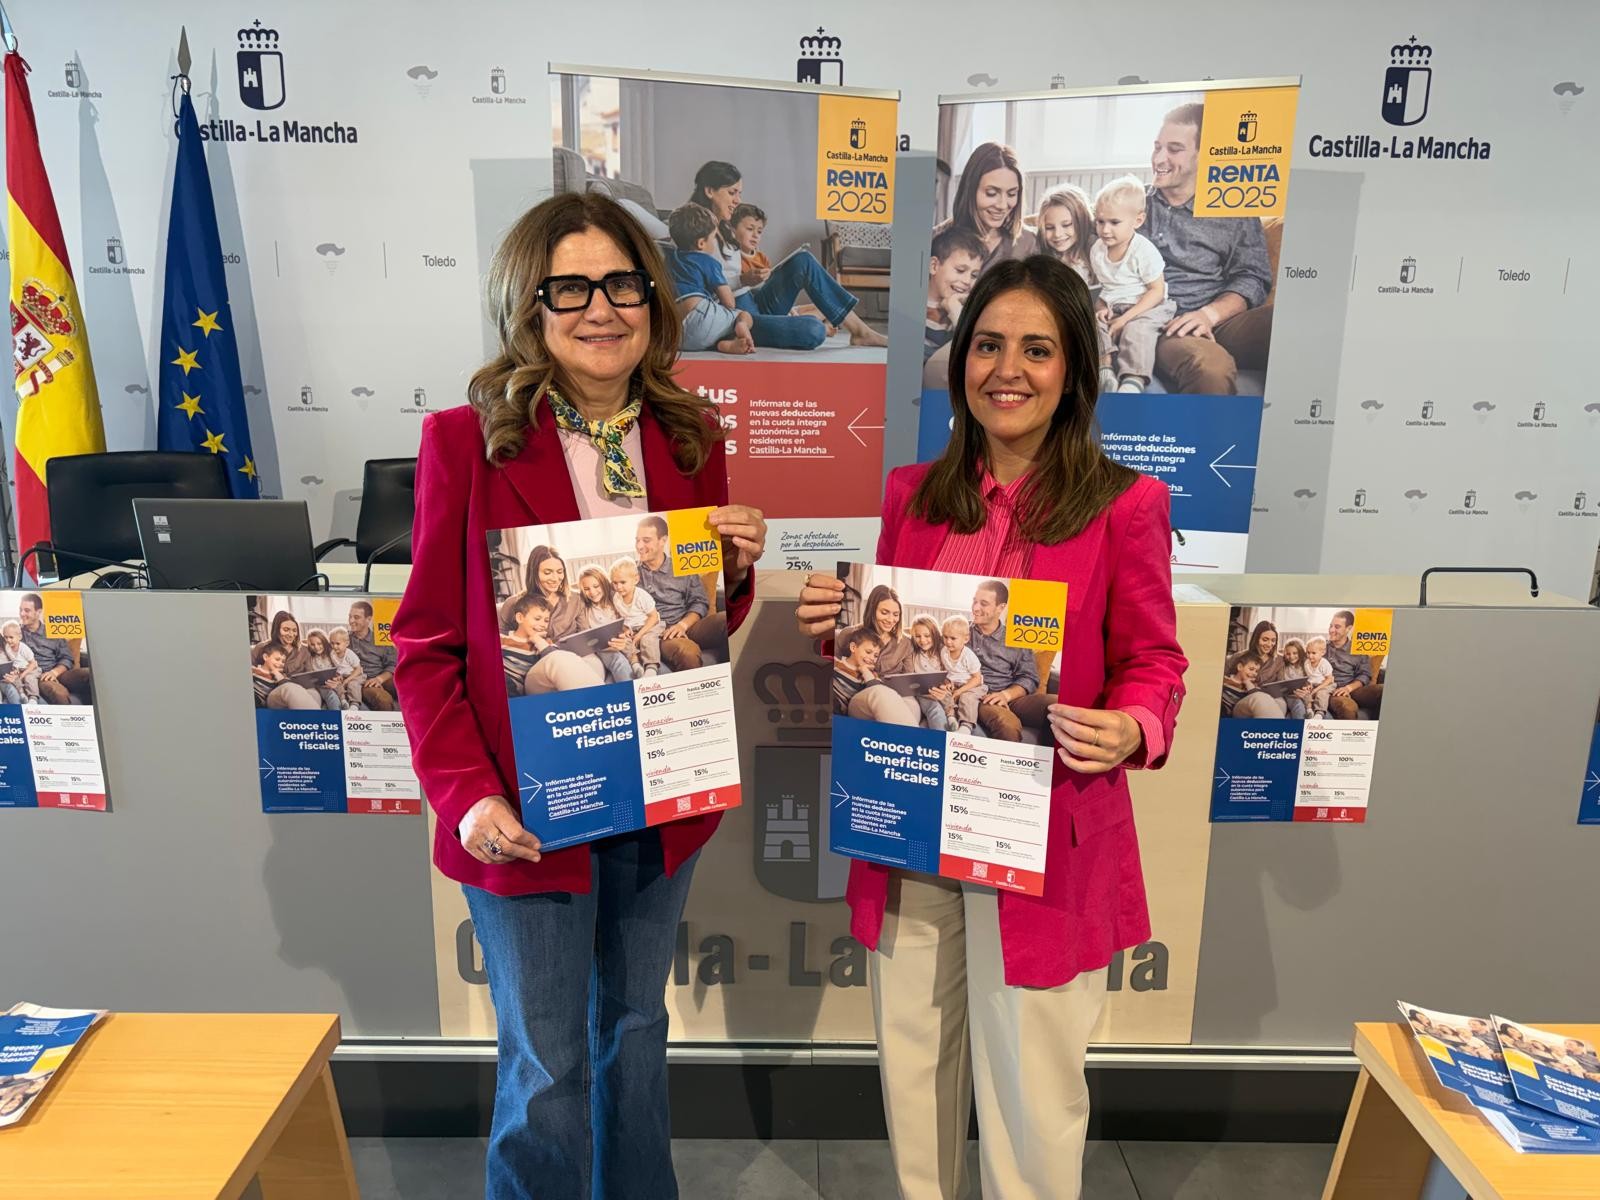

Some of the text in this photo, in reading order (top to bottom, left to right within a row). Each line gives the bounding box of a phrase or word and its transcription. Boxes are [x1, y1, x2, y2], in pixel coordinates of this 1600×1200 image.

[283, 120, 358, 143] Mancha
[1252, 145, 1282, 154] Mancha
[1417, 136, 1491, 160] Mancha
[863, 153, 888, 163] Mancha
[827, 190, 887, 214] 2025
[1206, 186, 1277, 208] 2025
[422, 254, 456, 267] Toledo
[1285, 266, 1318, 279] Toledo
[1498, 269, 1531, 282] Toledo
[1411, 286, 1434, 294] Mancha
[697, 385, 738, 404] tus
[749, 400, 818, 408] Infórmate de las
[780, 409, 836, 418] deducciones
[762, 418, 770, 426] la
[749, 437, 793, 445] residentes
[1101, 433, 1176, 443] Infórmate de las
[793, 446, 827, 454] Mancha
[1134, 444, 1197, 454] deducciones
[1112, 452, 1121, 461] la
[1122, 454, 1149, 462] cuota
[1155, 465, 1177, 473] para
[781, 531, 839, 540] Zonas afectadas
[780, 541, 791, 550] por
[802, 540, 844, 550] despoblación
[680, 552, 719, 570] 2025
[786, 561, 813, 570] 25%
[51, 624, 82, 635] 2025
[1013, 628, 1059, 645] 2025
[1357, 641, 1387, 651] 2025
[700, 680, 721, 690] 900€
[642, 691, 676, 706] 200€
[545, 701, 631, 724] Conoce tus
[4, 717, 21, 725] tus
[29, 717, 53, 725] 200€
[279, 721, 339, 731] Conoce tus
[690, 718, 710, 728] 100%
[347, 723, 373, 731] 200€
[552, 716, 632, 739] beneficios
[283, 732, 340, 741] beneficios
[646, 728, 662, 738] 30%
[1241, 730, 1299, 740] Conoce tus
[576, 730, 634, 749] fiscales
[299, 741, 340, 751] fiscales
[860, 737, 940, 759] Conoce tus
[1243, 741, 1298, 749] beneficios
[647, 748, 666, 760] 15%
[952, 751, 988, 766] 200€
[1257, 751, 1297, 760] fiscales
[864, 751, 940, 773] beneficios
[1015, 759, 1040, 769] 900€
[694, 768, 708, 776] 15%
[884, 768, 939, 786] fiscales
[649, 778, 664, 786] 15%
[951, 785, 969, 793] 30%
[584, 791, 598, 799] para
[999, 792, 1021, 802] 100%
[949, 805, 969, 815] 15%
[948, 832, 963, 840] 15%
[996, 840, 1012, 850] 15%
